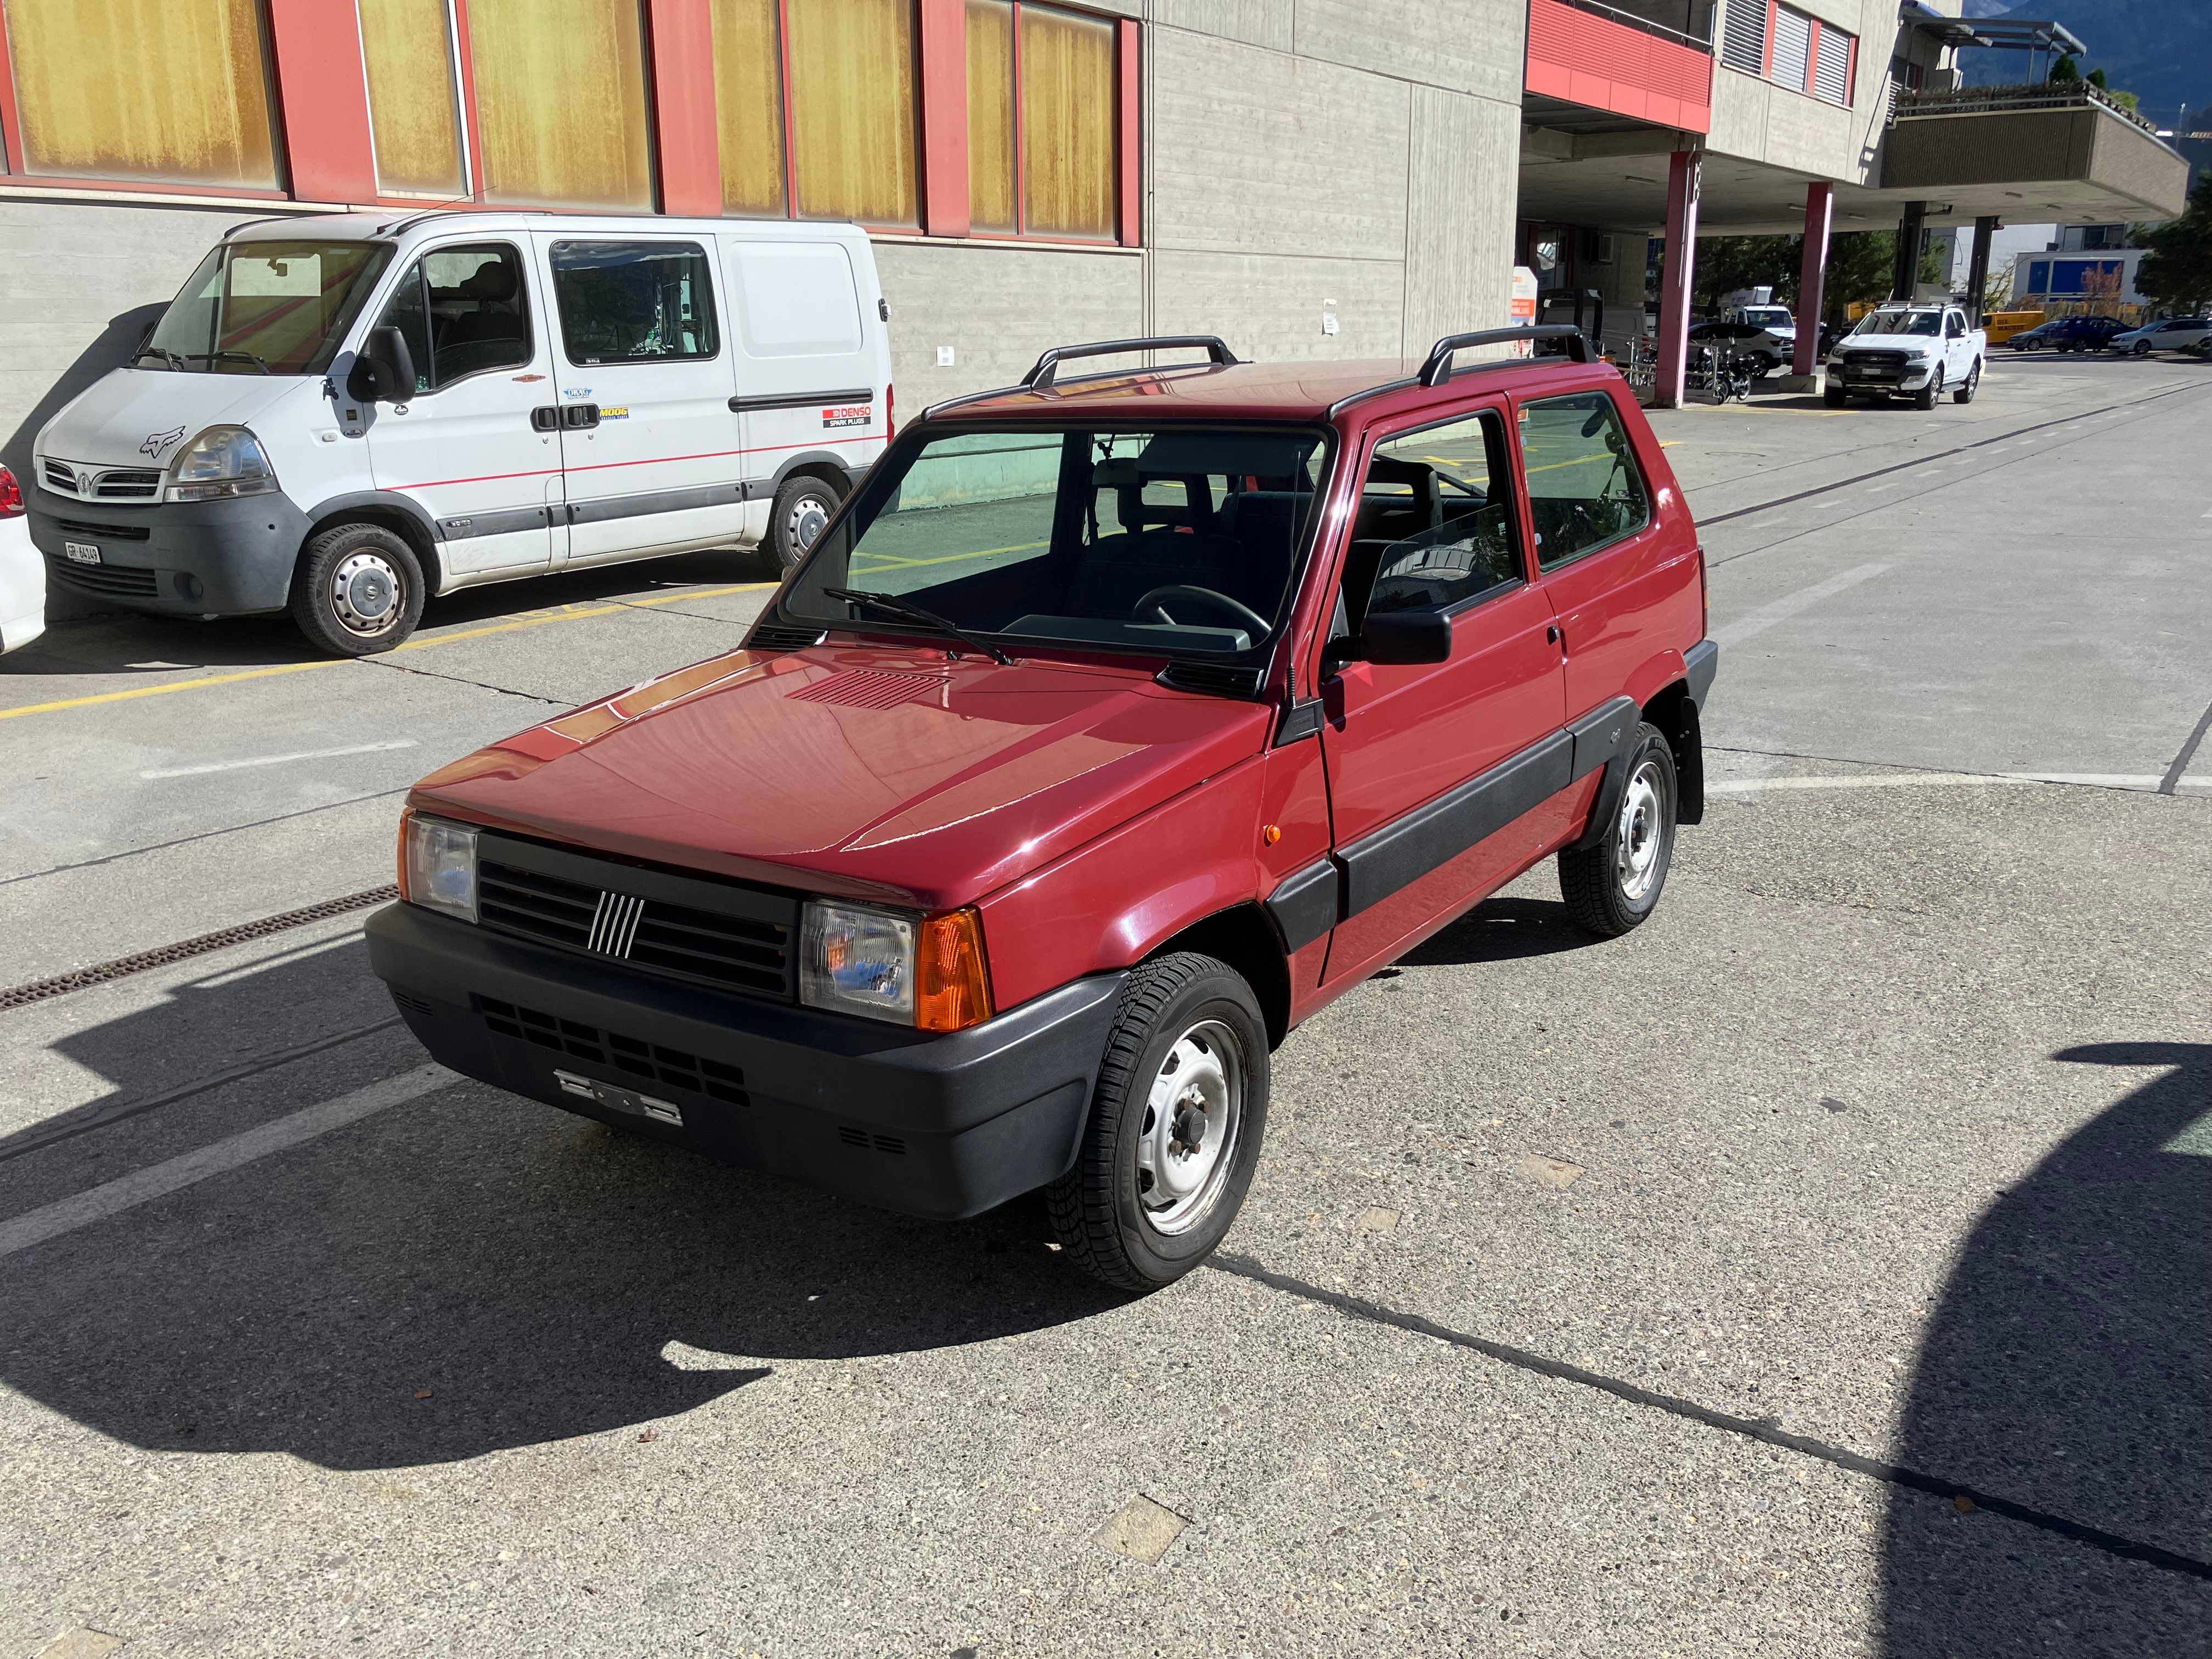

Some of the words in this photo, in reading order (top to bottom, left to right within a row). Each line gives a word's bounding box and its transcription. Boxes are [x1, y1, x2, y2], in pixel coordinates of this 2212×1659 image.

[567, 388, 590, 397] DRAG
[600, 408, 628, 417] MOOG
[841, 406, 871, 417] DENSO
